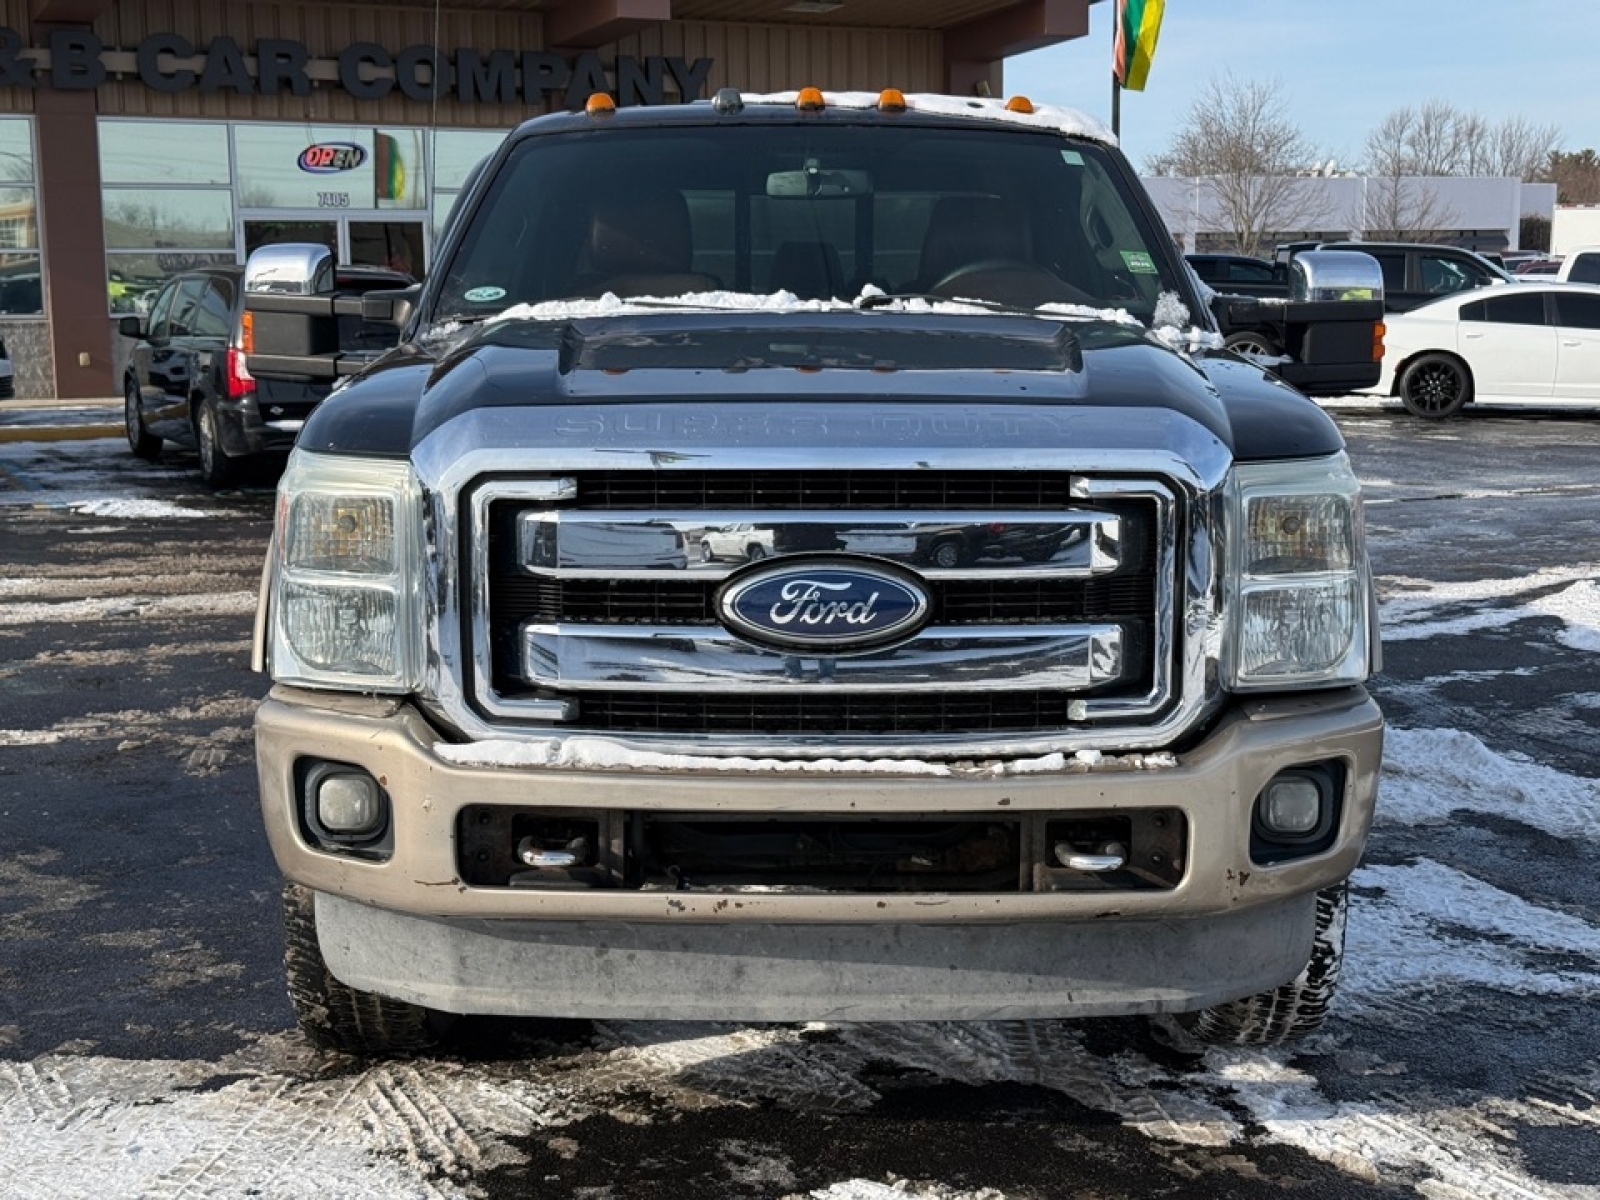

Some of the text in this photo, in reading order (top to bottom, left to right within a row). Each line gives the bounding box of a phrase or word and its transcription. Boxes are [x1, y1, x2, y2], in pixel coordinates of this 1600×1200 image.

[50, 31, 105, 89] B
[137, 32, 312, 95] CAR
[338, 42, 714, 111] COMPANY
[305, 146, 361, 168] OPEN
[554, 411, 1089, 436] SUPER DUTY
[769, 579, 880, 625] Ford
